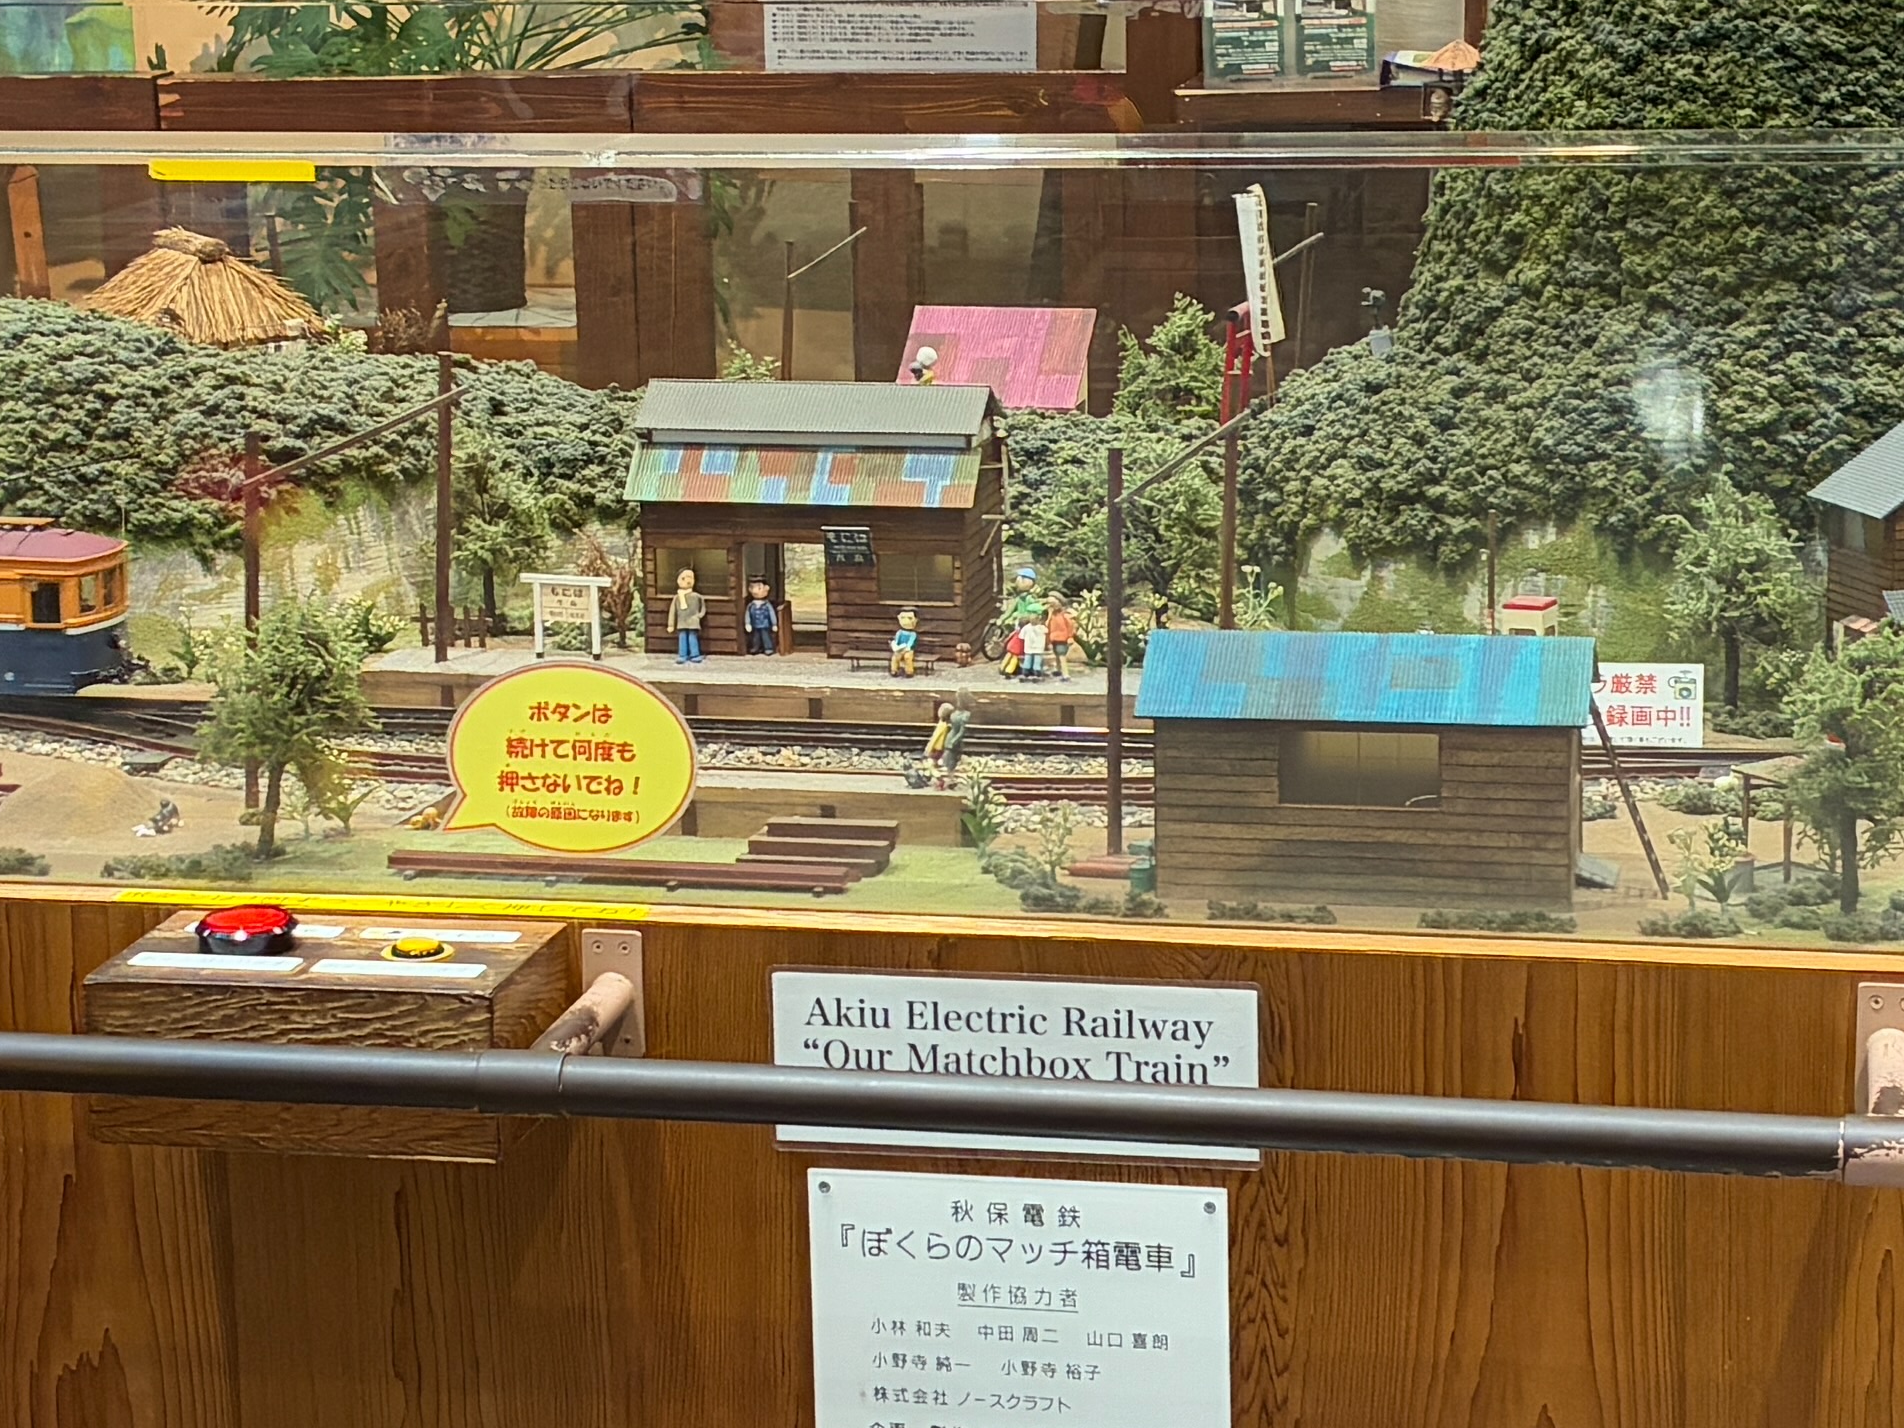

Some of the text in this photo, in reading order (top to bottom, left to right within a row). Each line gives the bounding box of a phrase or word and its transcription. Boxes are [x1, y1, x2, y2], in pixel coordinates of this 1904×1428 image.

[528, 701, 613, 725] ボタンは
[506, 736, 636, 762] 続けて何度も
[804, 996, 1213, 1049] Akiu Electric Railway
[907, 1041, 1093, 1081] Matchbox
[951, 1199, 1081, 1229] 秋保電鉄
[840, 1223, 1195, 1278] 『ぼくらのマッチ箱電車』
[957, 1282, 1078, 1308] 製作協力者
